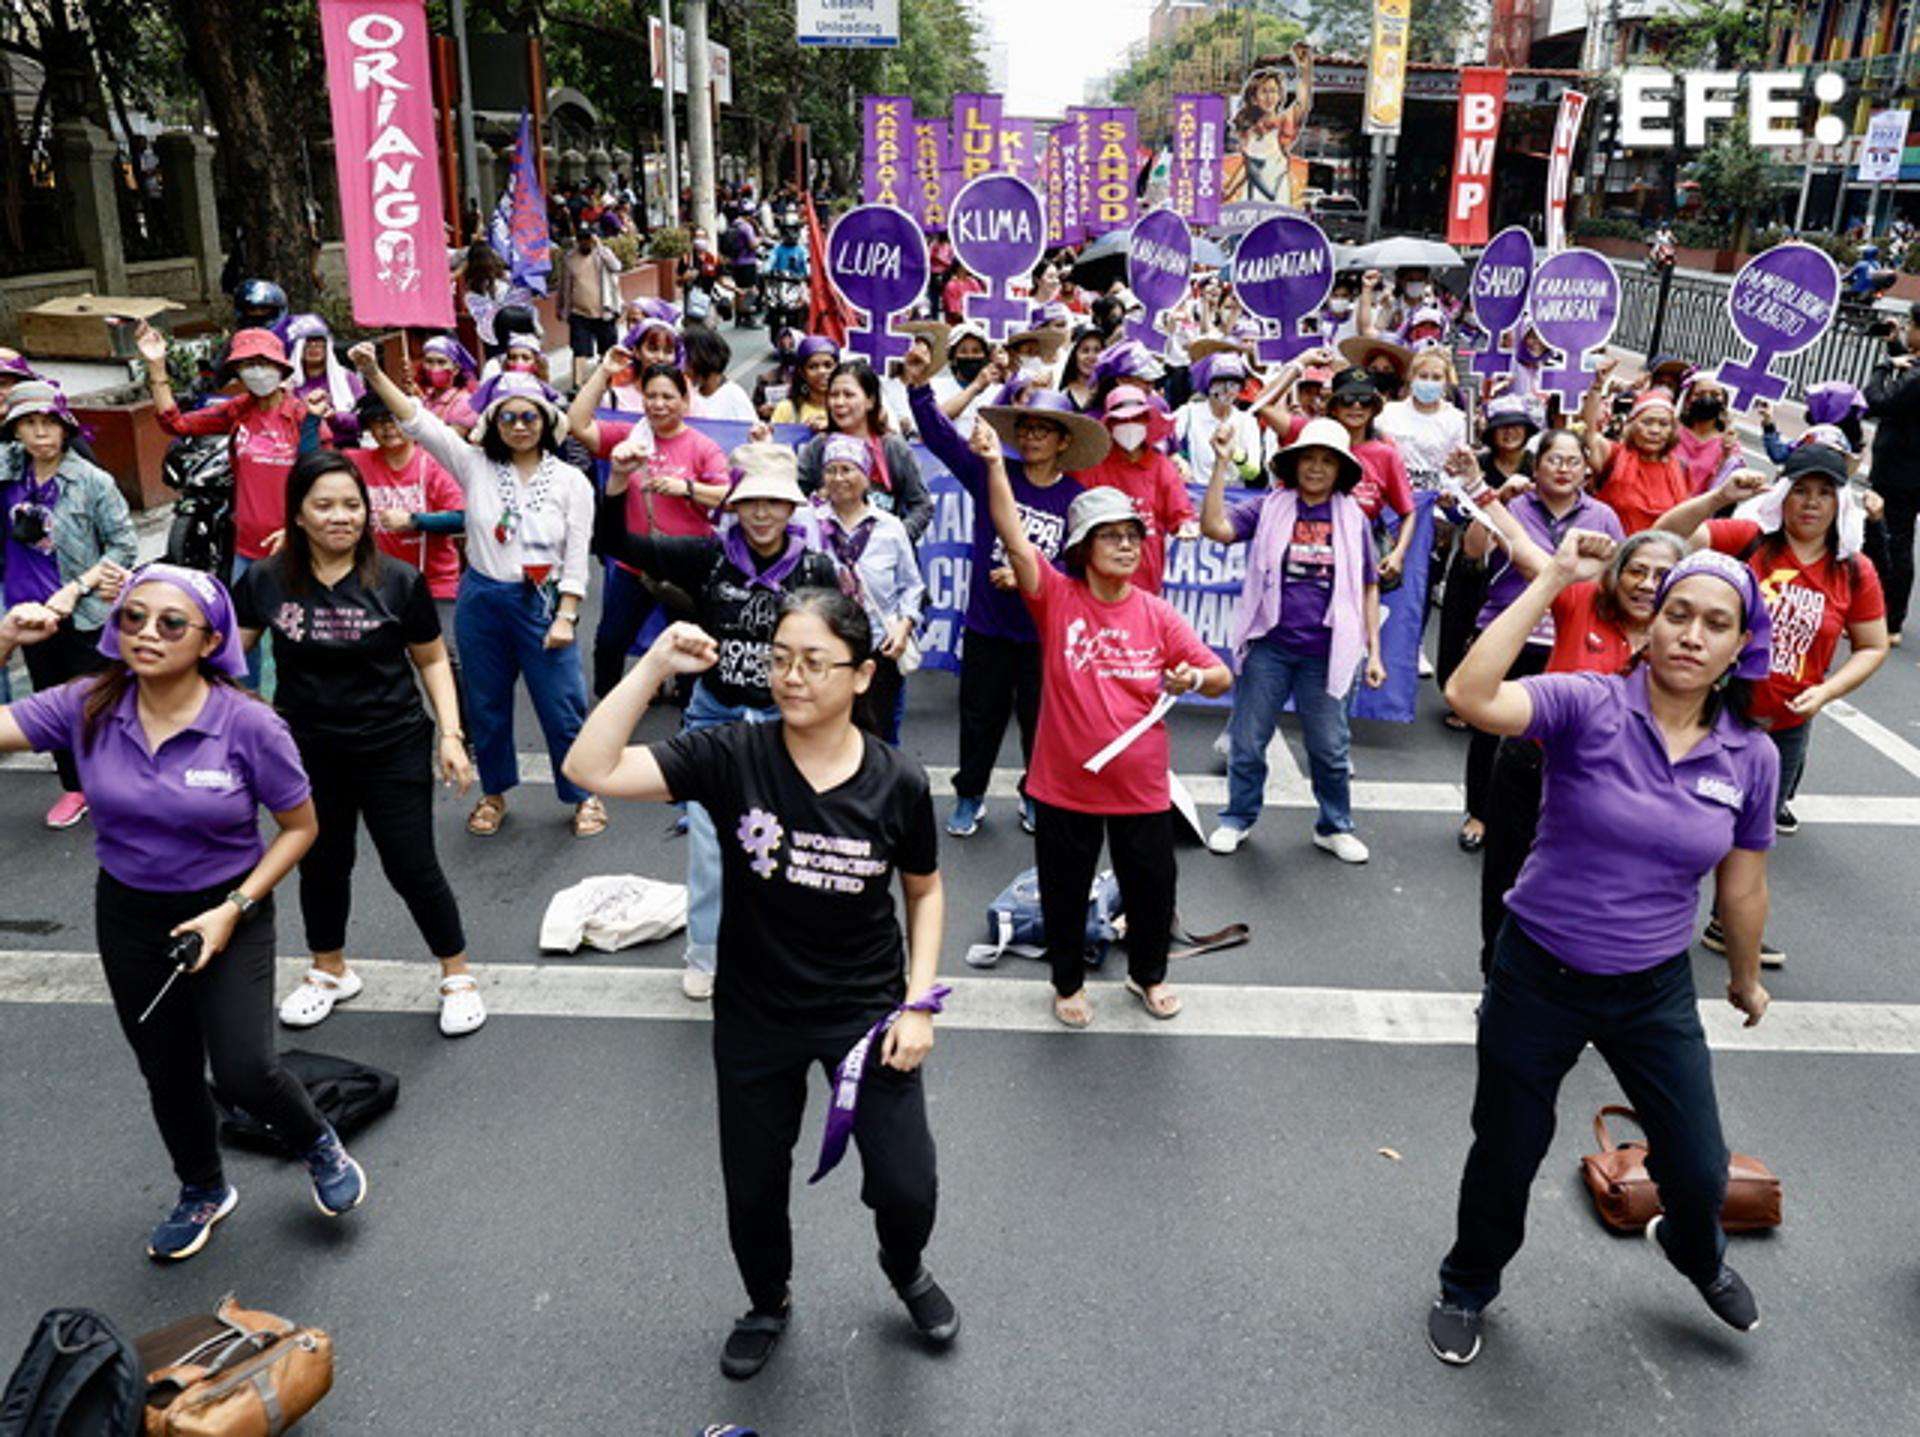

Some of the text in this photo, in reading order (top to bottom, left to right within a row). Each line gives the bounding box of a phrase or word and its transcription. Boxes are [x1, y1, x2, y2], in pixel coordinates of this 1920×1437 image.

[815, 20, 883, 35] Unloading
[874, 103, 899, 206] KARAPATA
[962, 107, 994, 181] LUP
[1456, 93, 1496, 220] BMP
[1098, 121, 1130, 223] SAHOD
[957, 208, 1033, 245] KLIMA
[836, 240, 902, 281] LUPA
[1477, 263, 1527, 299] SAHOD
[791, 829, 872, 857] WOMEN
[785, 864, 866, 895] UNITED
[789, 849, 888, 877] WORKERS
